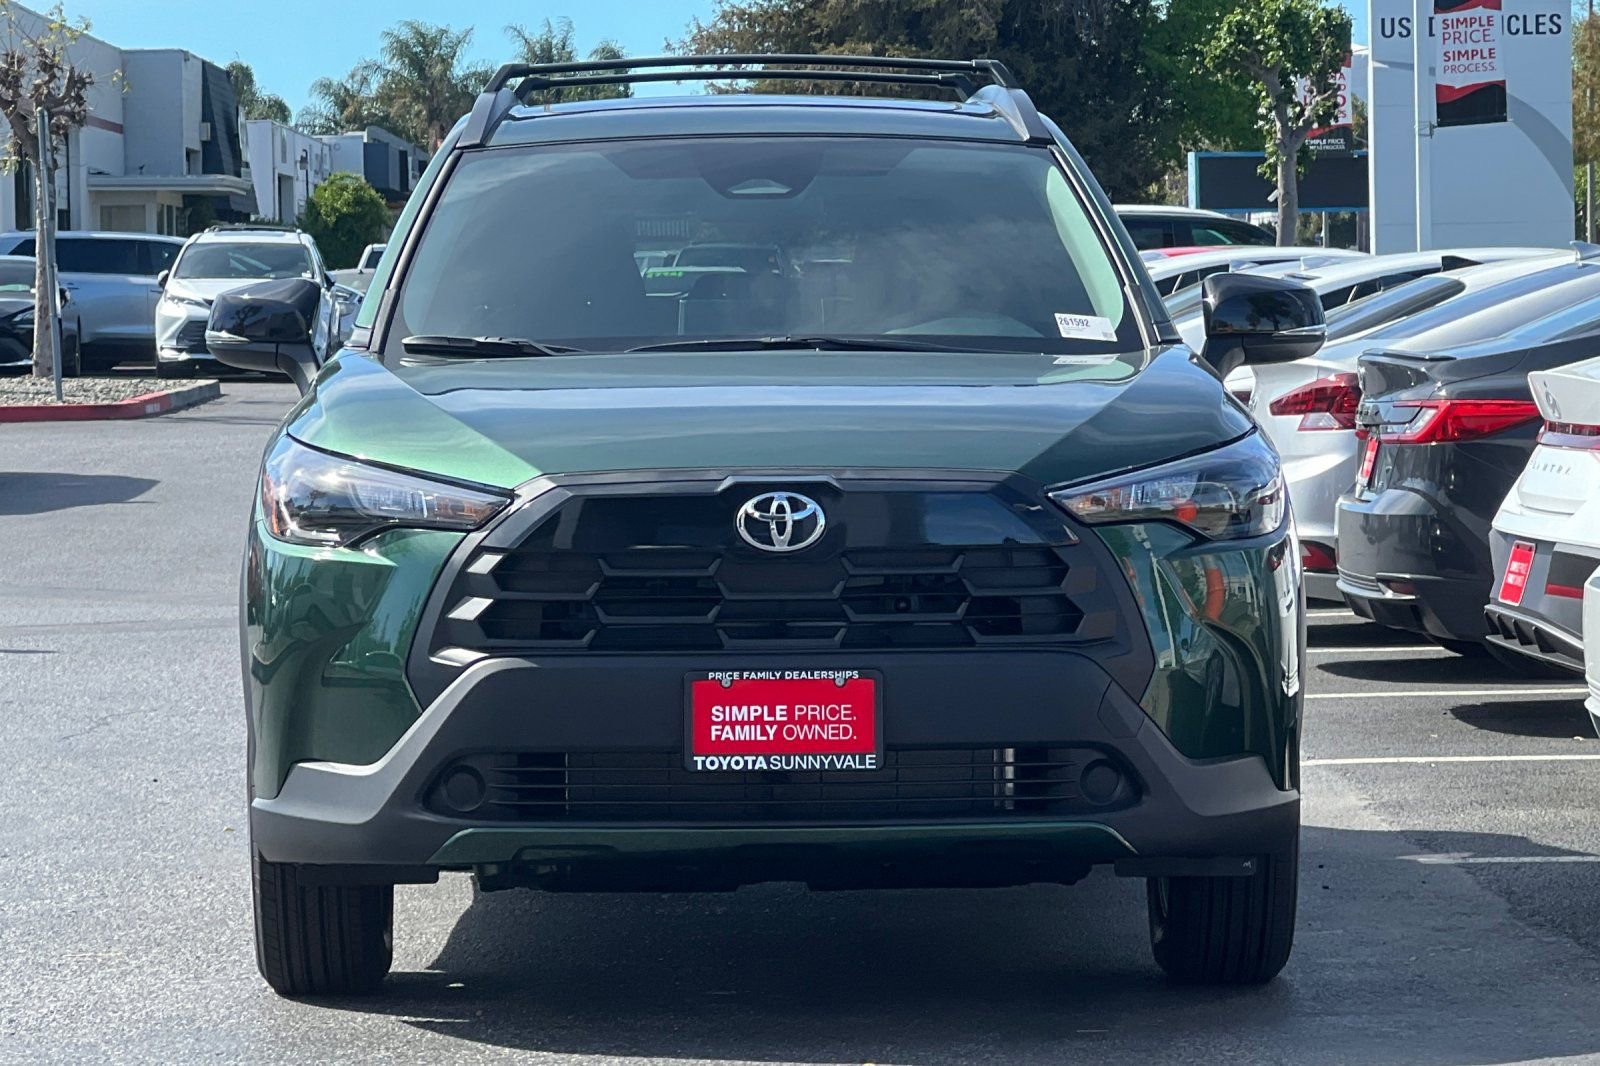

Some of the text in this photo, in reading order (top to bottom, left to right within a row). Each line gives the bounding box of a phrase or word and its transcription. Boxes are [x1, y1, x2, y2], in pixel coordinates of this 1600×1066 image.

[1442, 15, 1495, 30] SIMPLE
[1442, 28, 1496, 45] PRICE.
[1443, 48, 1496, 62] SIMPLE
[1443, 62, 1497, 74] PROCESS.
[1058, 317, 1090, 328] 261592
[708, 671, 859, 681] PRICE FAMILY DEALERSHIPS
[711, 704, 857, 722] SIMPLE PRICE.
[711, 724, 857, 741] FAMILY OWNED.
[693, 754, 876, 770] TOYOTA SUNNYVALE
